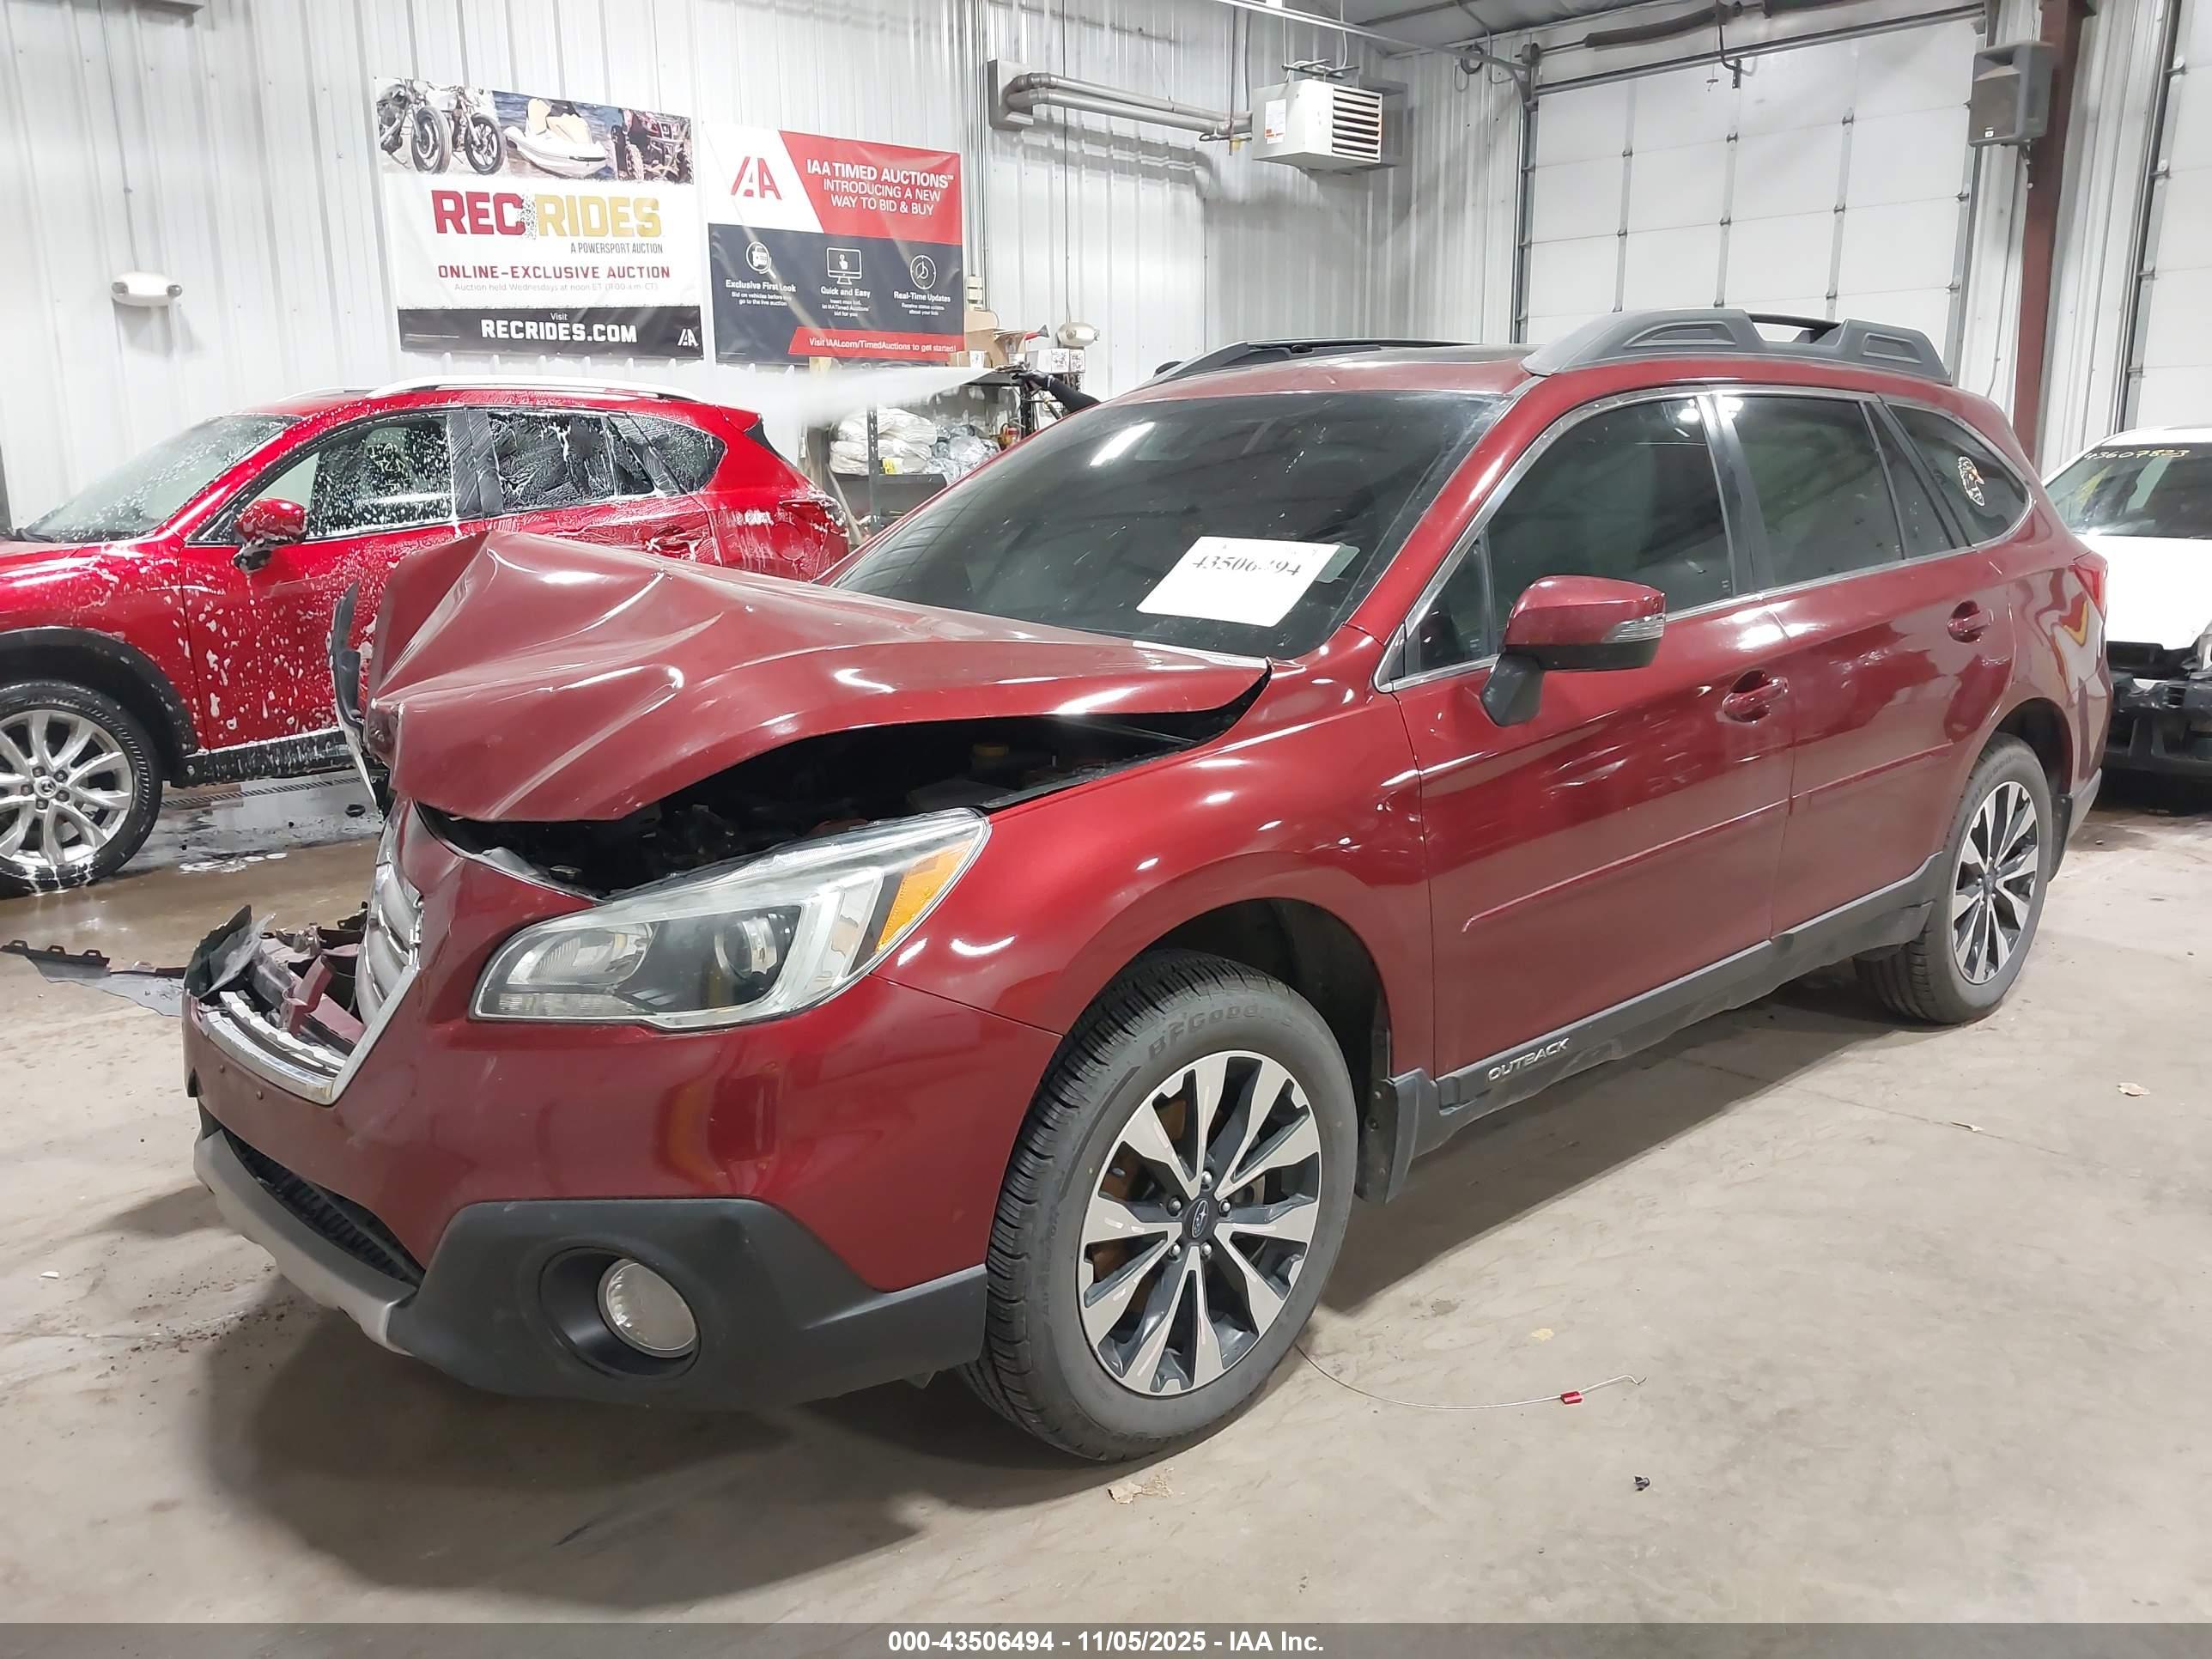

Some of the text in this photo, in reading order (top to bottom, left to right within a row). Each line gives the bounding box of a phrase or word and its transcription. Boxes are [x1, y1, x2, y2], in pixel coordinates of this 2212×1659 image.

[806, 159, 830, 174] IAA
[834, 162, 877, 179] TIMED
[823, 179, 940, 202] INTRODUCING A NEW
[831, 194, 934, 215] WAY TO BID & BUY
[431, 190, 662, 237] REC RIDES
[570, 243, 663, 254] A POWERSPORT AUCTION
[438, 264, 670, 279] ONLINE-EXCLUSIVE AUCTION
[726, 279, 761, 289] Exclusive
[763, 282, 779, 290] First
[821, 286, 839, 295] Quick
[854, 289, 871, 298] Easy
[894, 291, 951, 302] Real-Time Updates
[550, 313, 568, 321] Visit
[481, 319, 637, 343] RECRIDES.COM
[809, 337, 825, 346] Visit
[921, 343, 932, 353] get
[1488, 1037, 1569, 1081] OUTBACK
